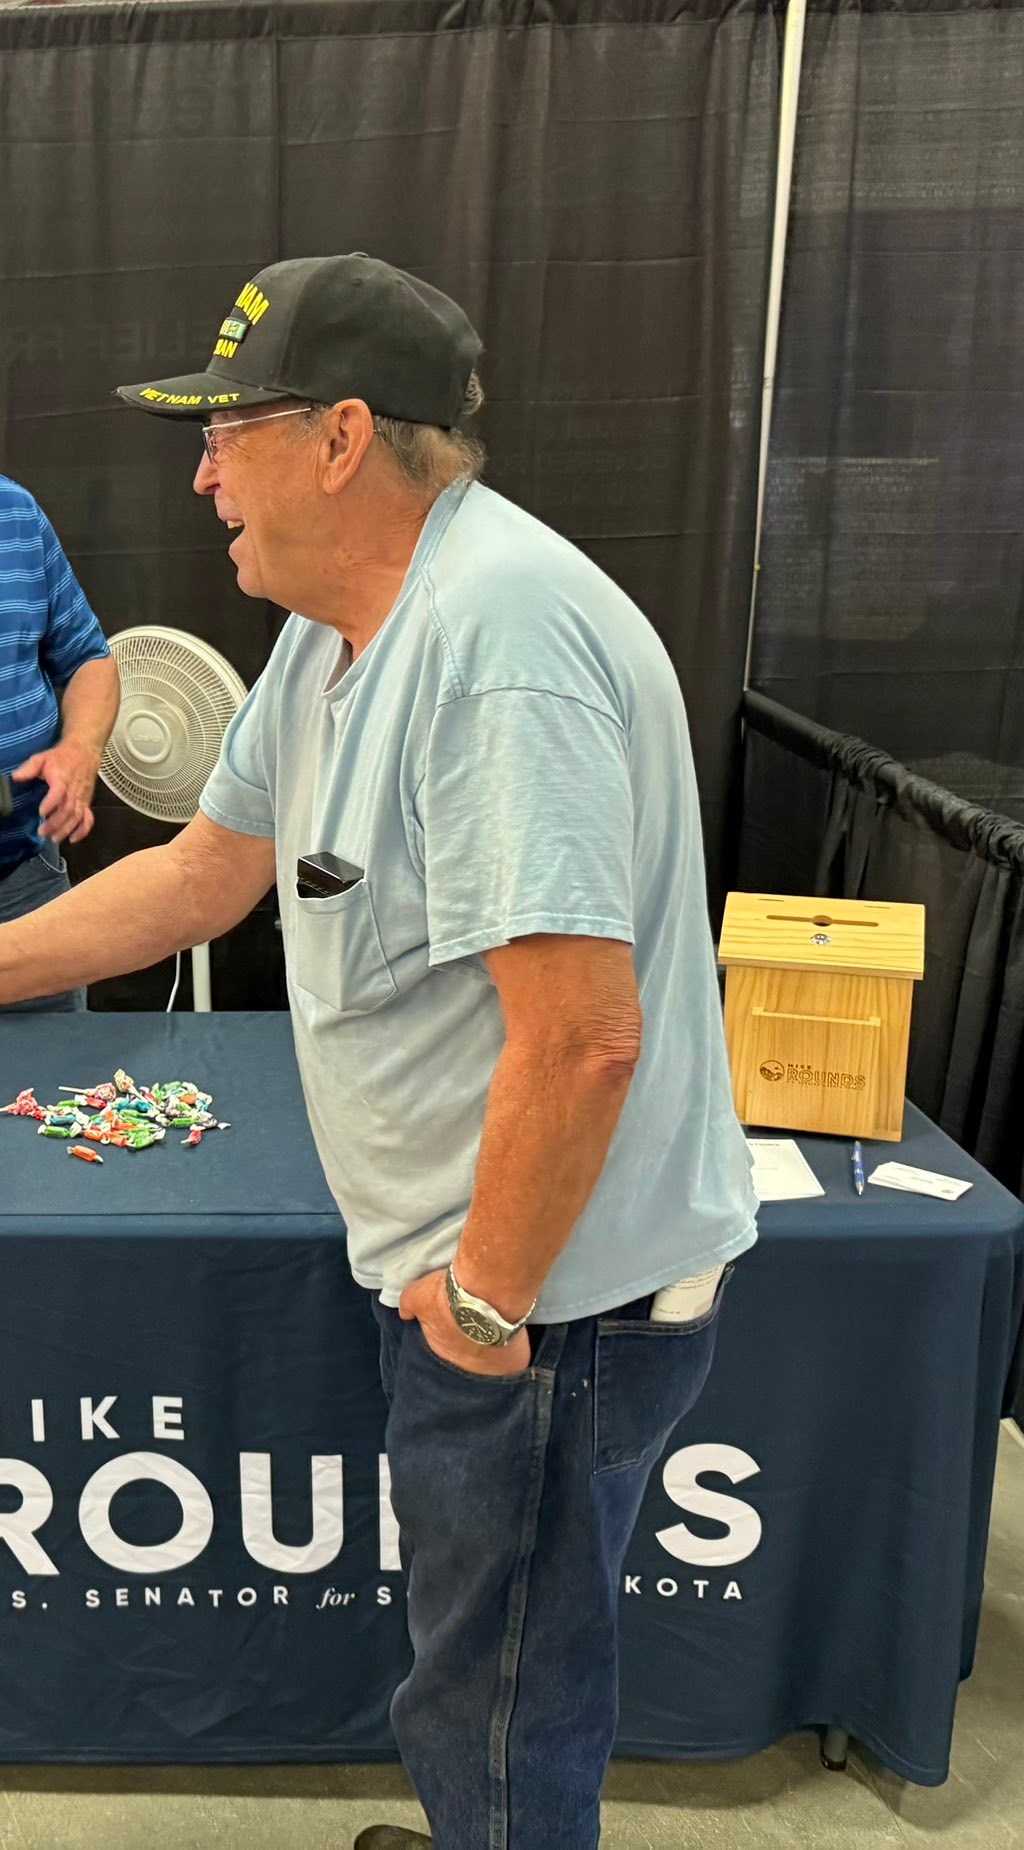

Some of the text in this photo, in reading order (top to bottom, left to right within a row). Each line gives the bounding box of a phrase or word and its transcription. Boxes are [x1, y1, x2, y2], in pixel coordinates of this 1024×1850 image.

[139, 388, 240, 405] VIETNAM VET
[786, 1068, 866, 1088] ROUNDS
[85, 1586, 289, 1608] SENATOR
[316, 1588, 355, 1609] for
[625, 1575, 742, 1600] KOTA
